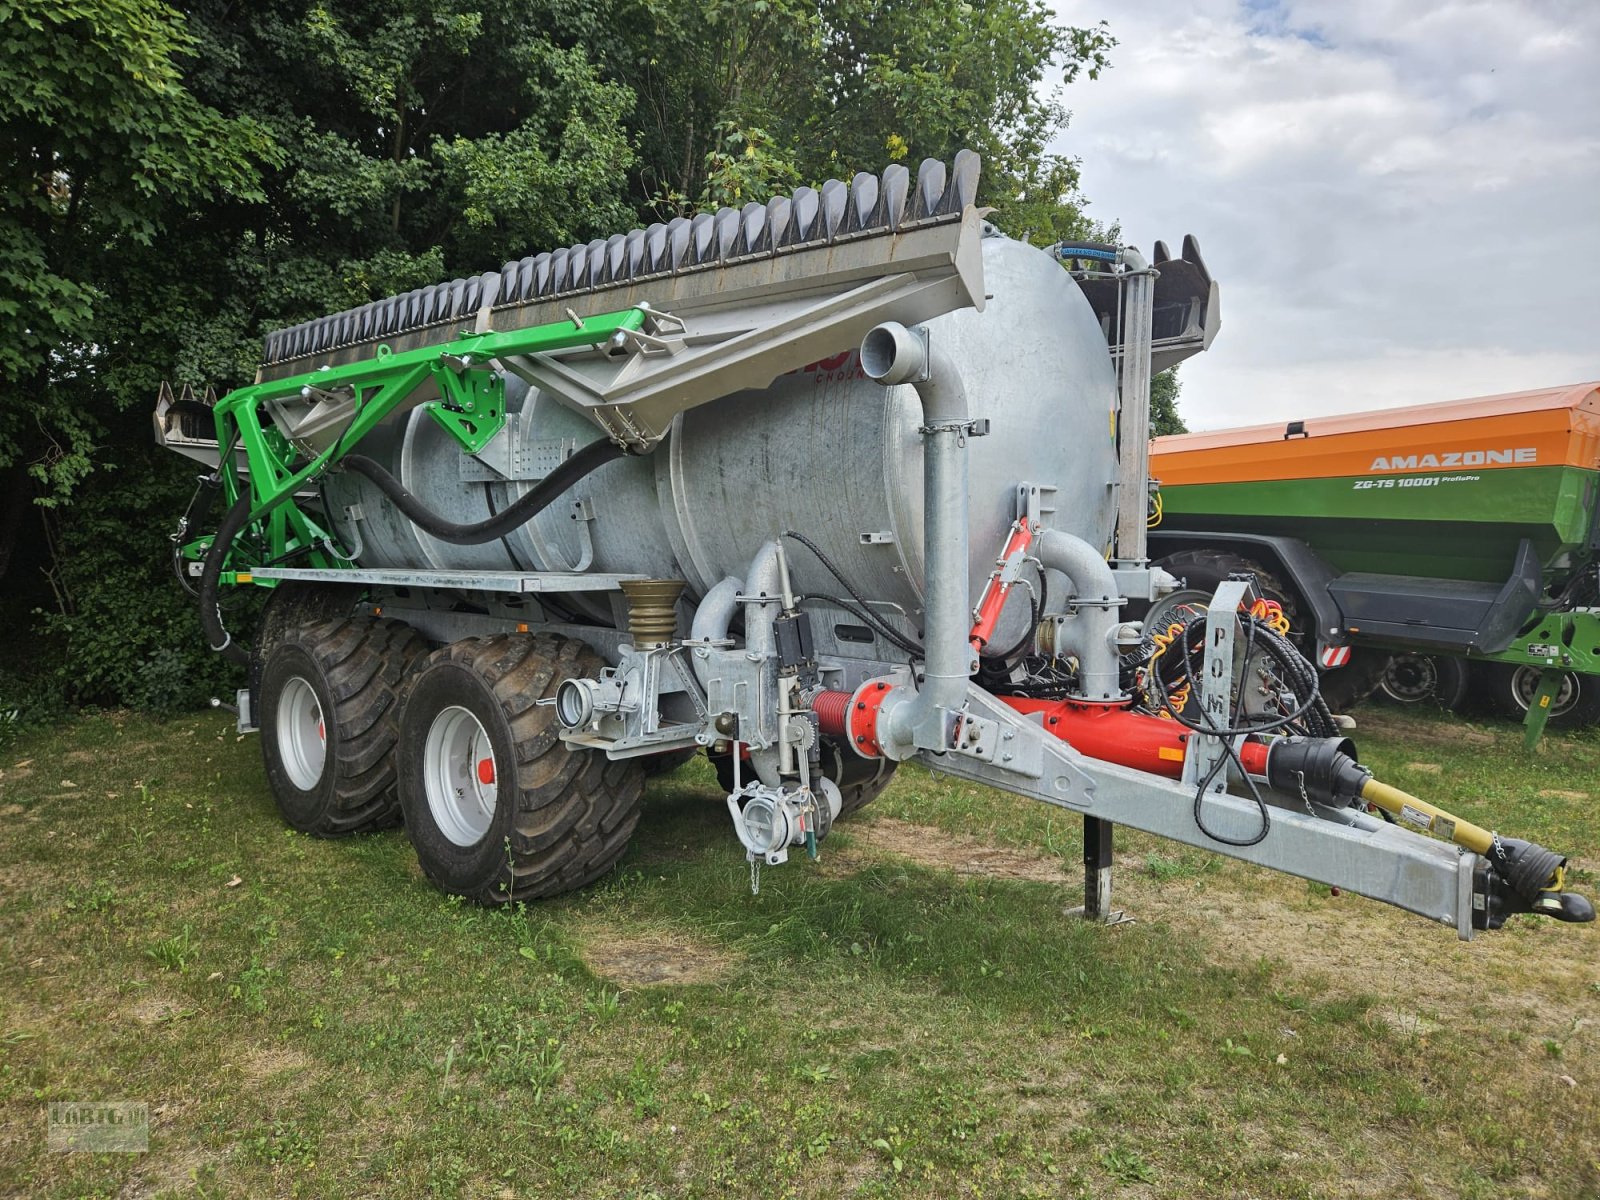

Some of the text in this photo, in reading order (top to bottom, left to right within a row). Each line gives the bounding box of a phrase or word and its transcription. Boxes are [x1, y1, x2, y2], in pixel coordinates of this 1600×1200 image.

[1369, 448, 1537, 471] AMAZONE
[1353, 479, 1395, 490] ZG-TS
[1398, 476, 1440, 488] 10001
